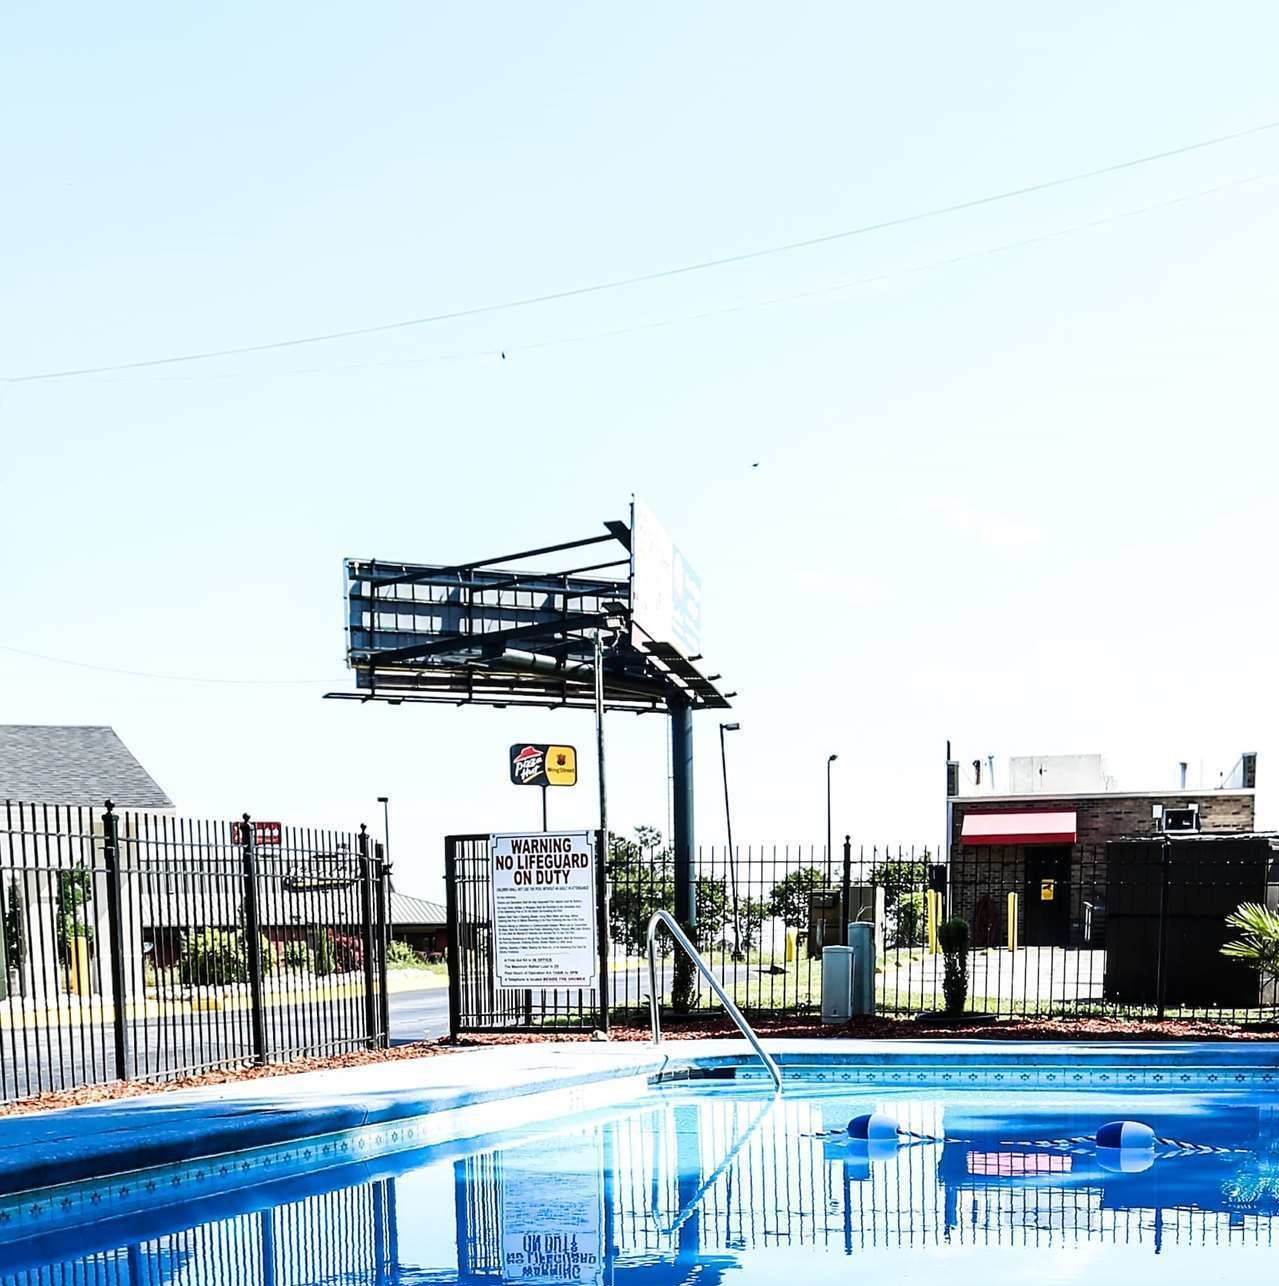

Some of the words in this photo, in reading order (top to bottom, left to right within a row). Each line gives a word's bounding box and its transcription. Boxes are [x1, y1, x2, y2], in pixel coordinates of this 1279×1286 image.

[515, 757, 543, 776] Pizza
[520, 765, 541, 780] Hut
[511, 838, 572, 854] WARNING
[496, 855, 513, 870] NO
[517, 853, 589, 870] LIFEGUARD
[514, 871, 534, 886] ON
[536, 870, 571, 885] DUTY
